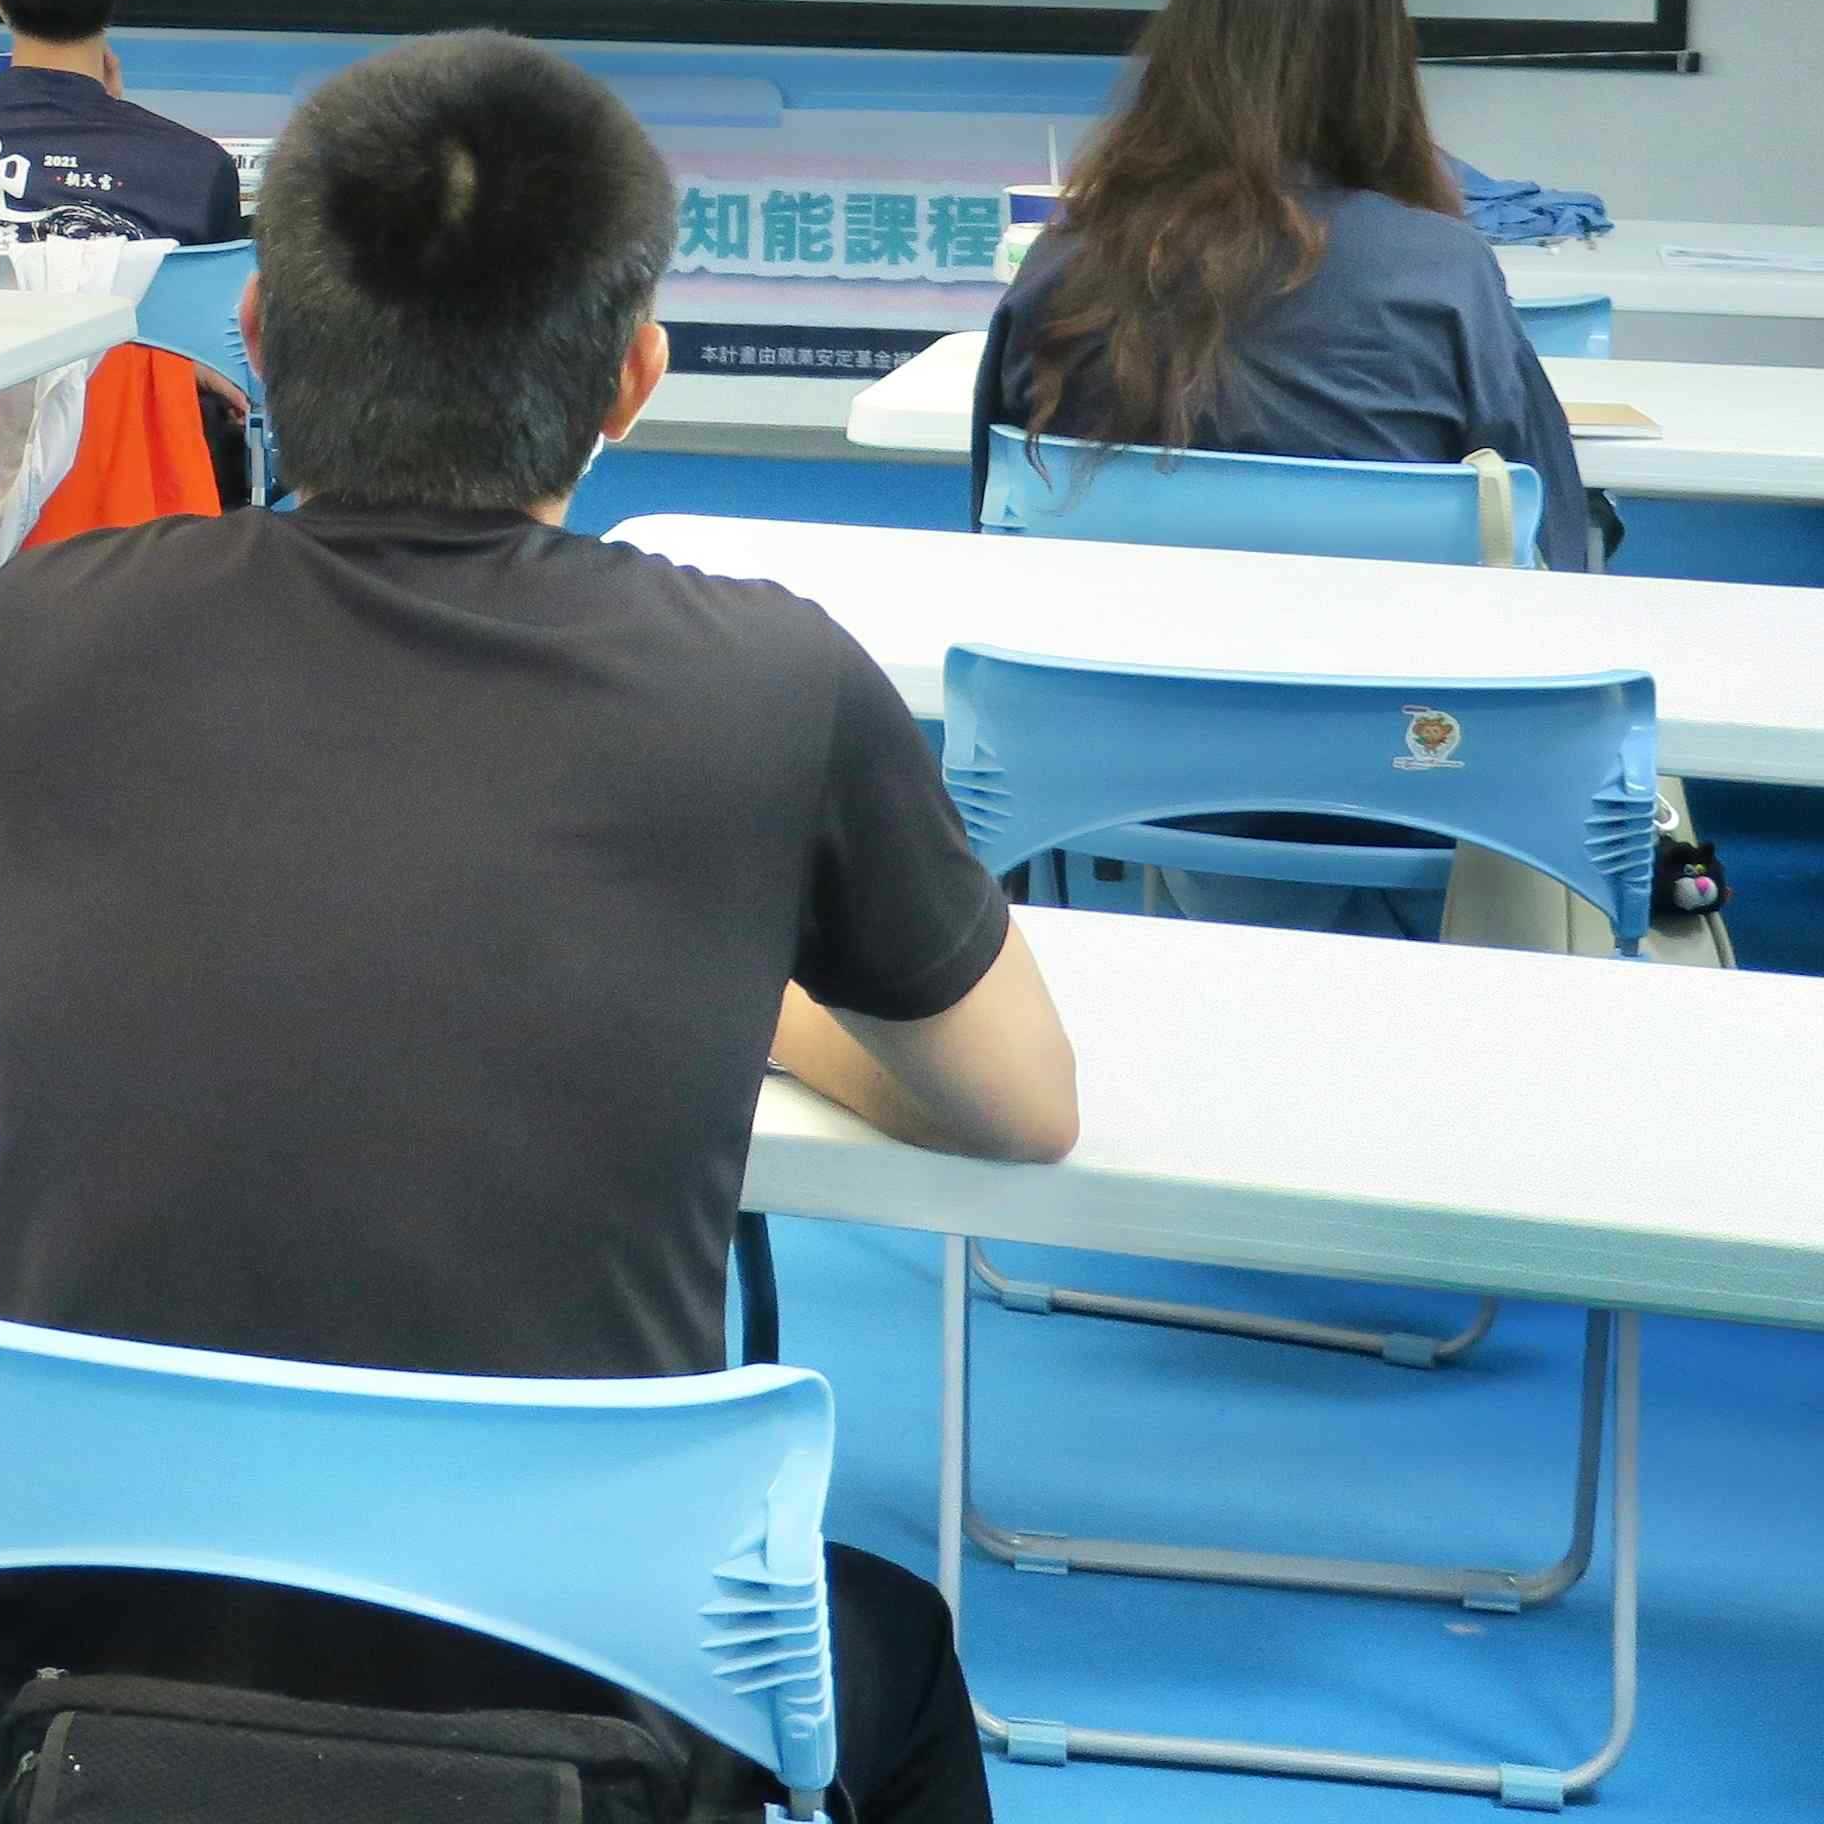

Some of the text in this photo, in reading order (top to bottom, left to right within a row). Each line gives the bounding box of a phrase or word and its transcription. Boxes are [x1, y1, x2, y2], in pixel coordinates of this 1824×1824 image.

[44, 155, 78, 168] 2021
[679, 187, 1001, 268] 知能課程
